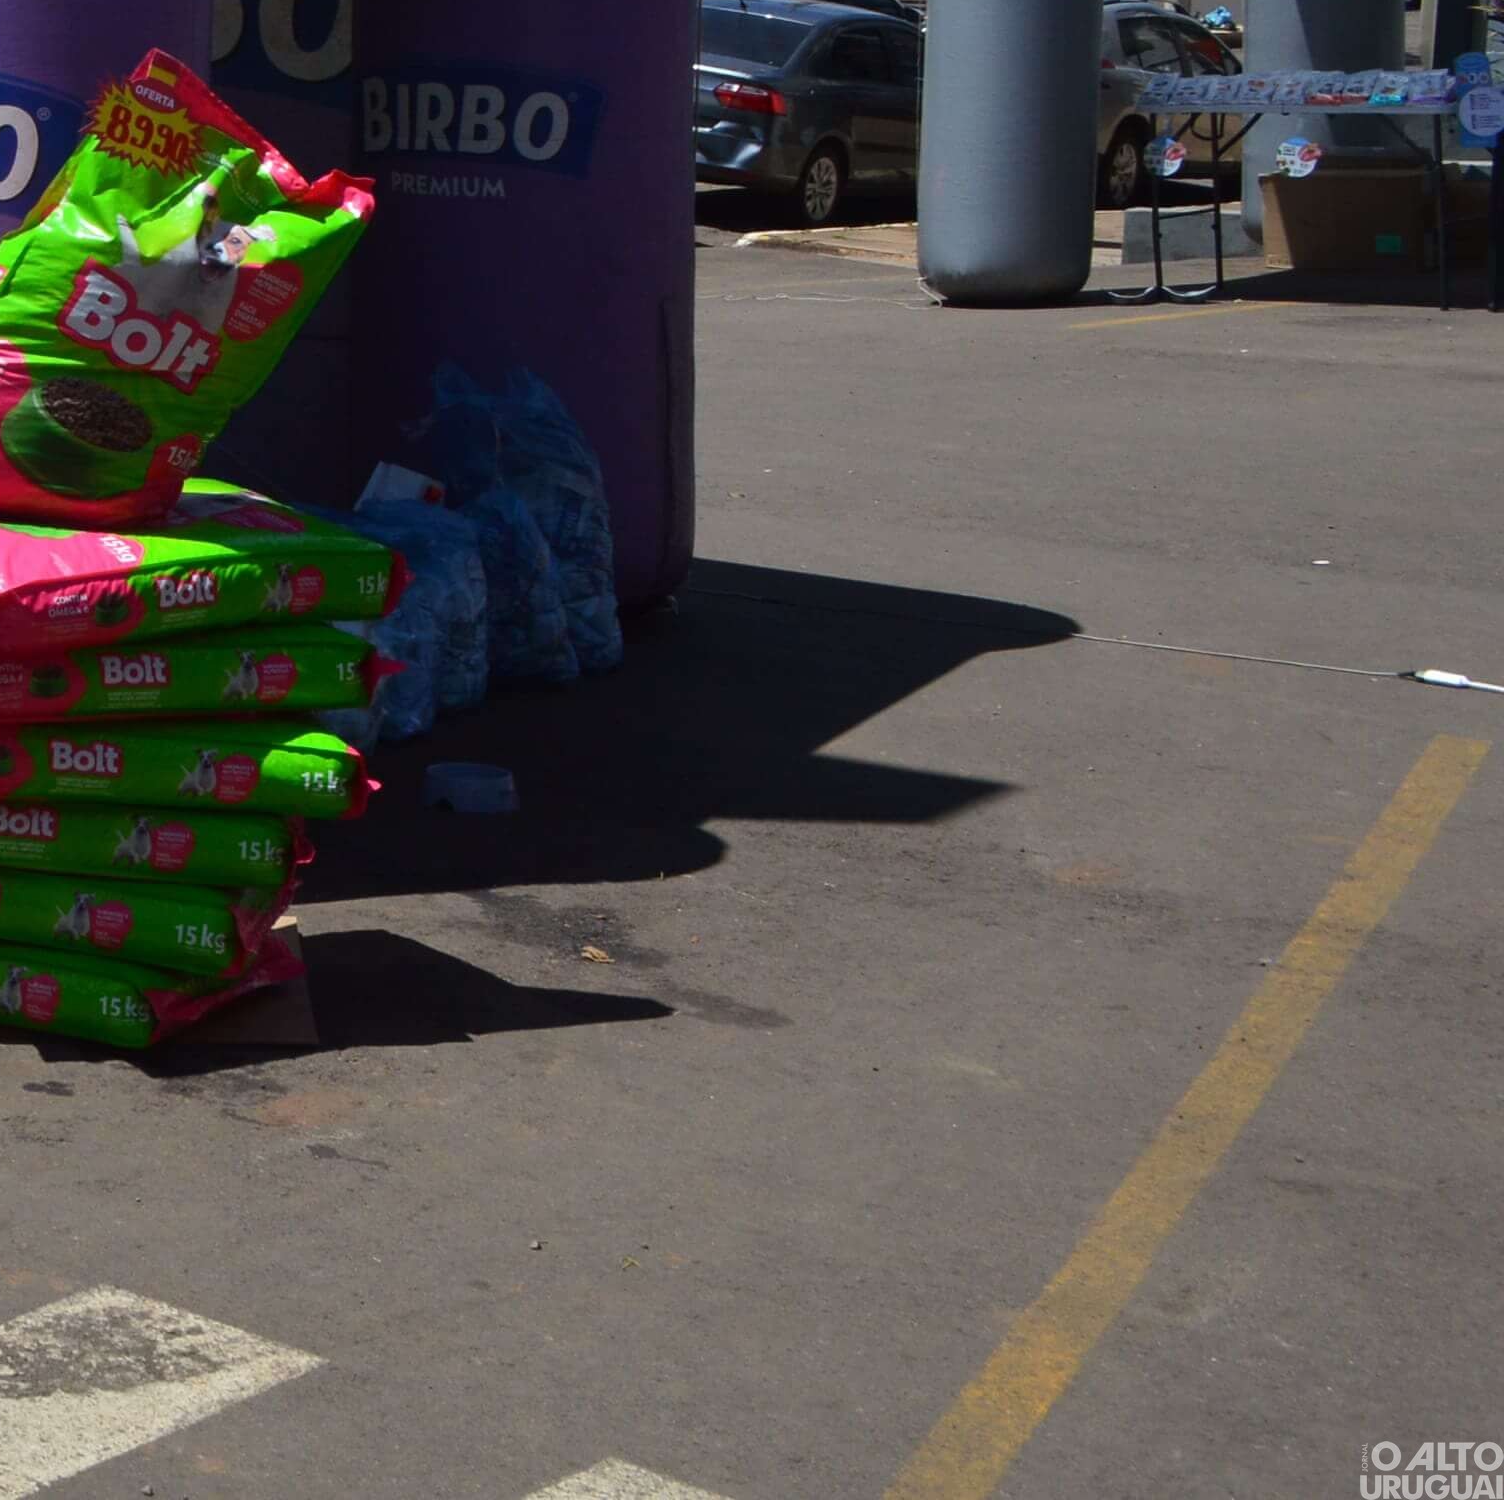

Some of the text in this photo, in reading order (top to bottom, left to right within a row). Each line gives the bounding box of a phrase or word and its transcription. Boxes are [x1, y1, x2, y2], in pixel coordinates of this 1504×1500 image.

[135, 84, 176, 109] OFERTA
[362, 76, 569, 162] BIRBO
[392, 171, 505, 198] PREMIUM
[66, 270, 211, 384] Bolt
[158, 572, 215, 608] Bolt
[101, 655, 167, 685] Bolt
[51, 741, 118, 773] Bolt
